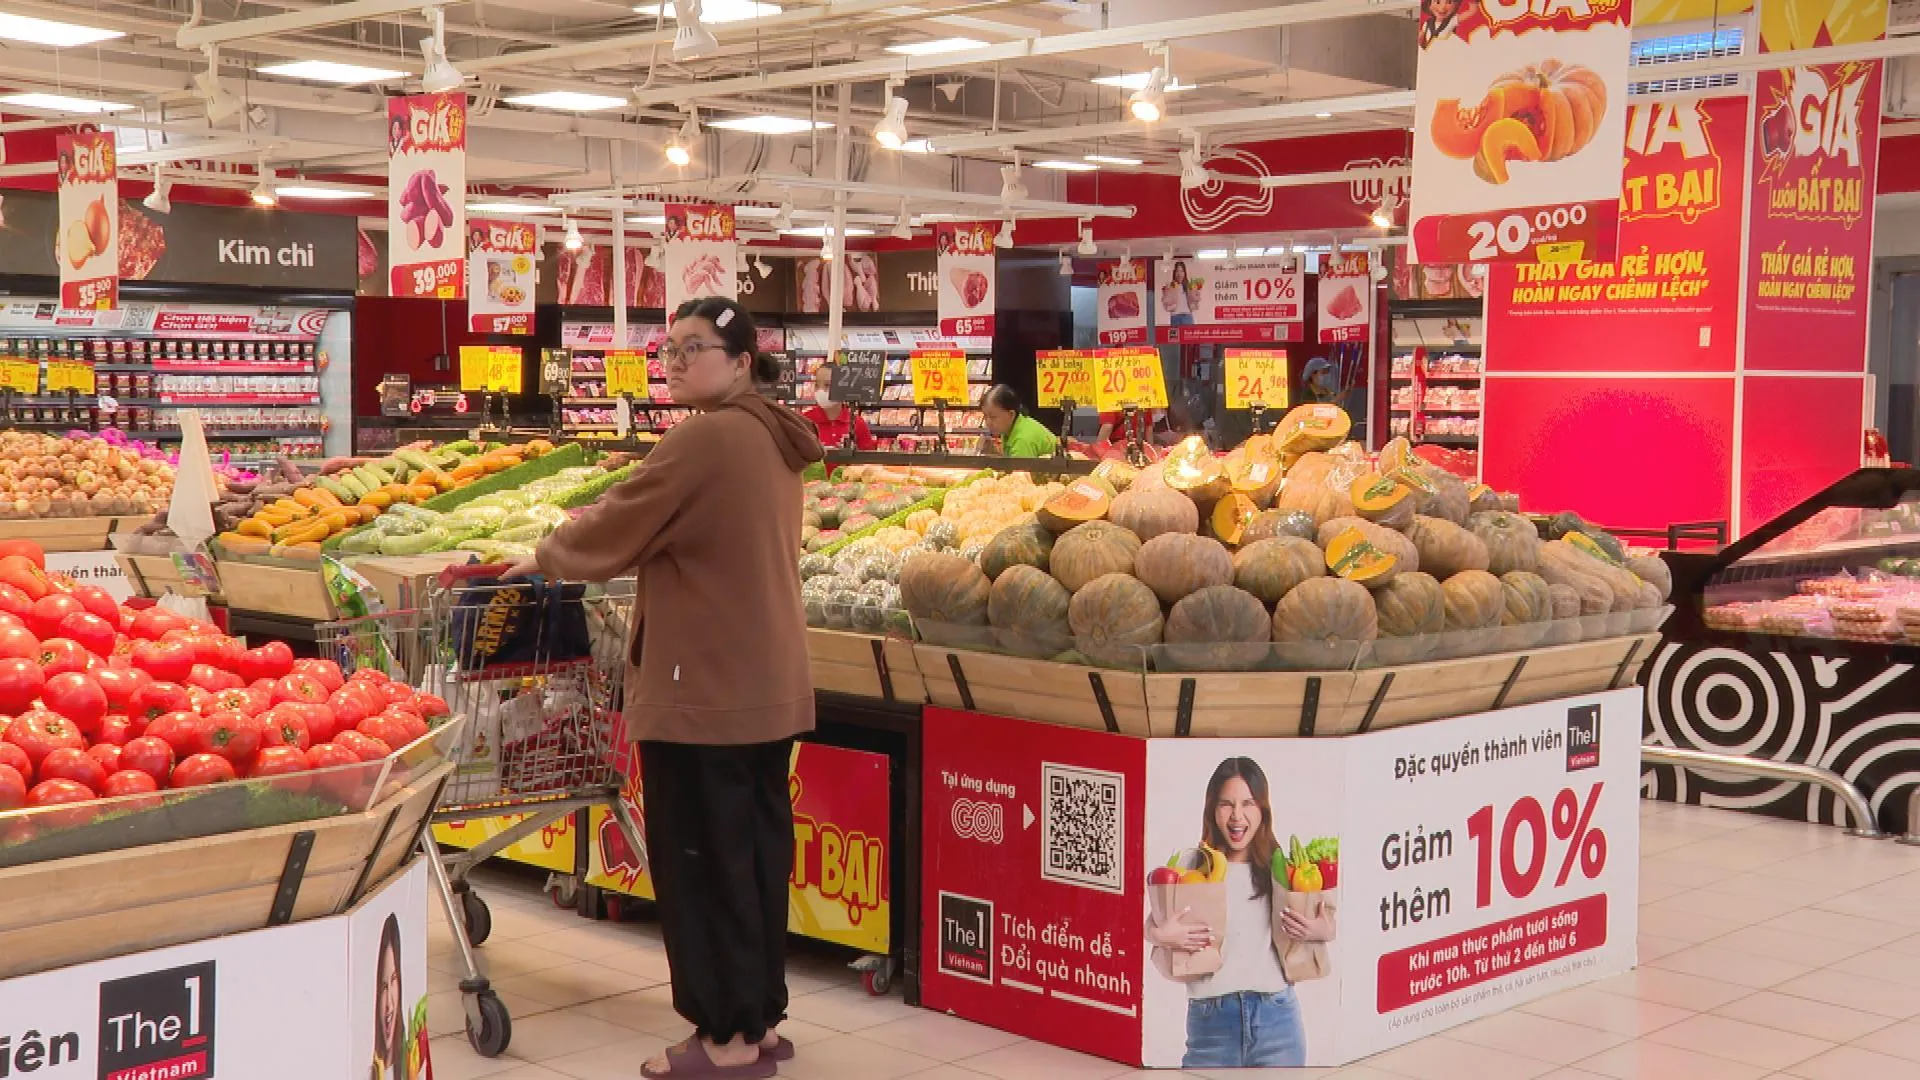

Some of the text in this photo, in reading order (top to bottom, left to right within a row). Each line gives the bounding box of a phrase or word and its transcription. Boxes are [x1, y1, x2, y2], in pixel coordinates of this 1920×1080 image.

[410, 104, 450, 145] GIÁ
[1656, 168, 1714, 214] BẠI
[1798, 156, 1831, 212] BẤT
[1833, 179, 1861, 217] BẠI
[489, 226, 524, 249] GIÁ
[686, 211, 723, 237] GIÁ
[219, 239, 313, 266] Kim chi
[1621, 246, 1649, 277] RẺ
[1761, 240, 1791, 274] THẤY
[1792, 246, 1812, 276] GIÁ
[1243, 278, 1295, 300] 10%
[1512, 282, 1554, 304] HOÀN
[1558, 285, 1603, 302] NGAY
[1606, 279, 1656, 299] CHÊNH
[1394, 728, 1562, 782] Đặc quyền thành viên
[961, 774, 982, 792] ứng
[986, 778, 1015, 798] dụng
[951, 798, 1003, 844] GO!
[1381, 824, 1452, 870] Giảm
[1466, 781, 1607, 909] 10%
[1379, 886, 1451, 931] thêm
[1001, 914, 1036, 941] Tích
[1041, 921, 1084, 952] điểm
[1090, 932, 1112, 957] dễ
[1409, 910, 1578, 970] Khi mua thực phẩm tươi sống
[949, 953, 983, 972] Vietnam
[1001, 943, 1131, 996] Đổi quà nhanh
[1409, 973, 1442, 996] trước
[1491, 951, 1511, 970] thứ
[1514, 948, 1521, 963] 2
[1524, 942, 1545, 960] đến
[1548, 934, 1567, 952] thứ
[1569, 932, 1576, 946] 6
